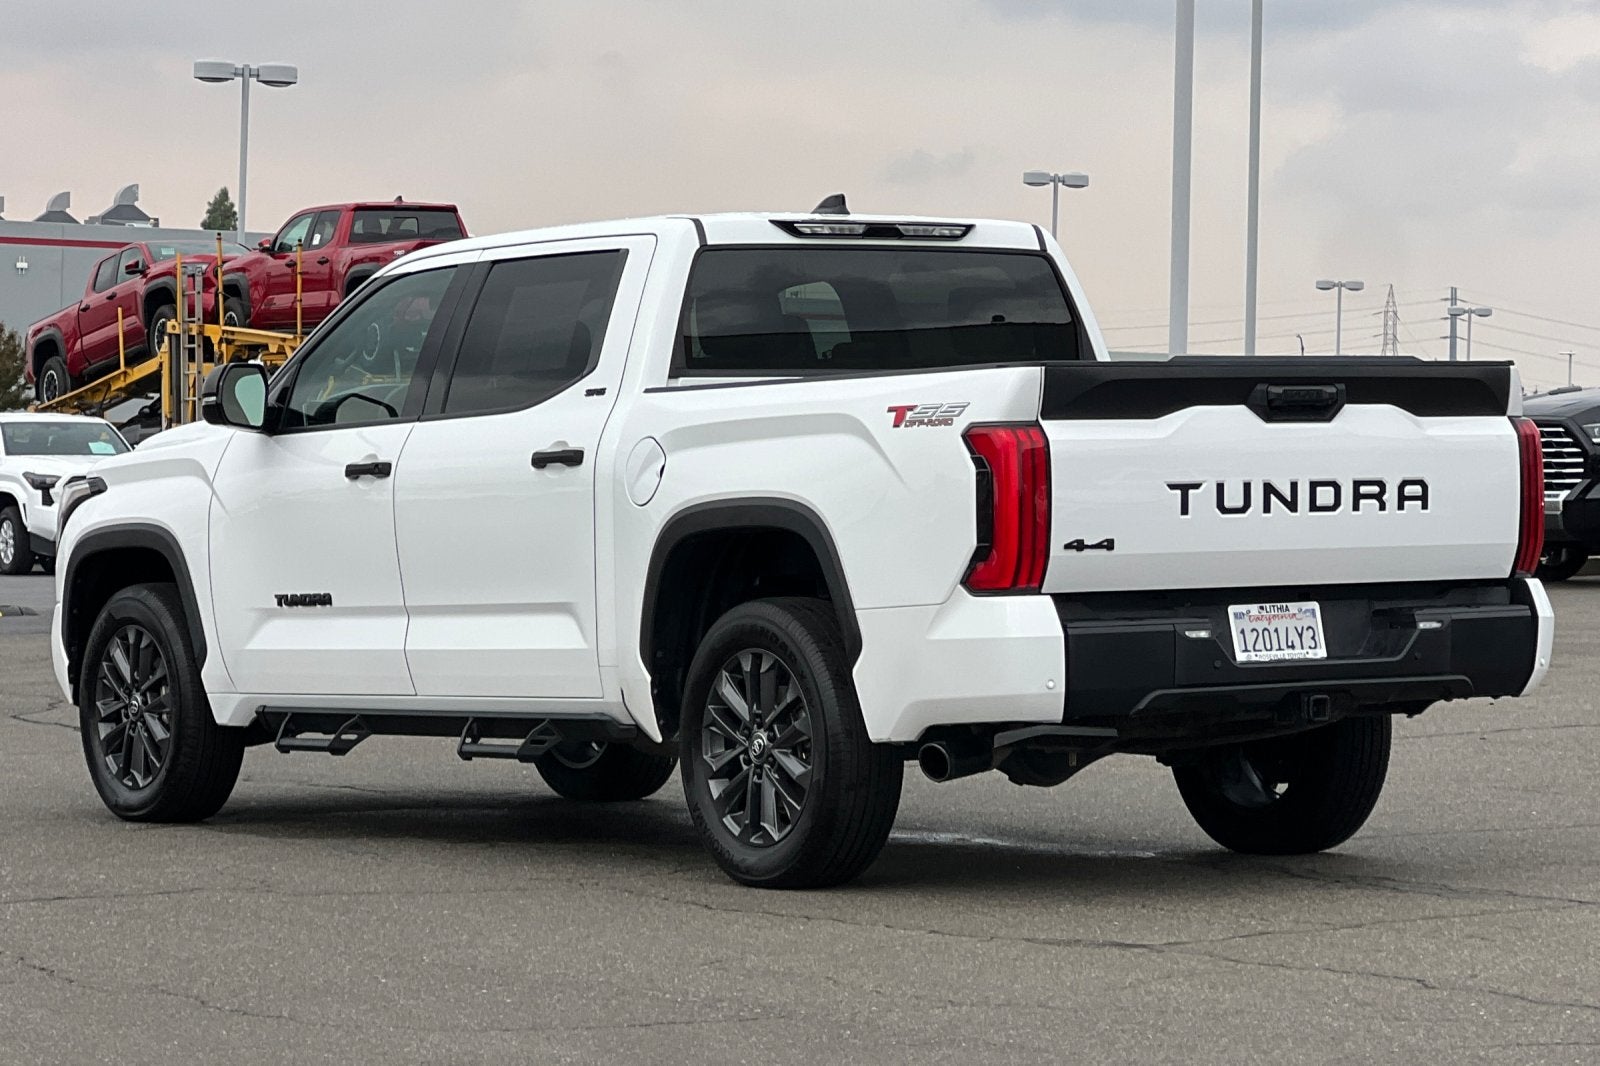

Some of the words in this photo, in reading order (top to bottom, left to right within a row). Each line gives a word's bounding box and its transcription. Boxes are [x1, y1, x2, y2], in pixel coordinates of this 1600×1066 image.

[1165, 477, 1431, 518] TUNDRA
[273, 592, 333, 608] TUNDRA
[1265, 604, 1290, 614] LITHIA
[1239, 626, 1318, 653] 12014Y3
